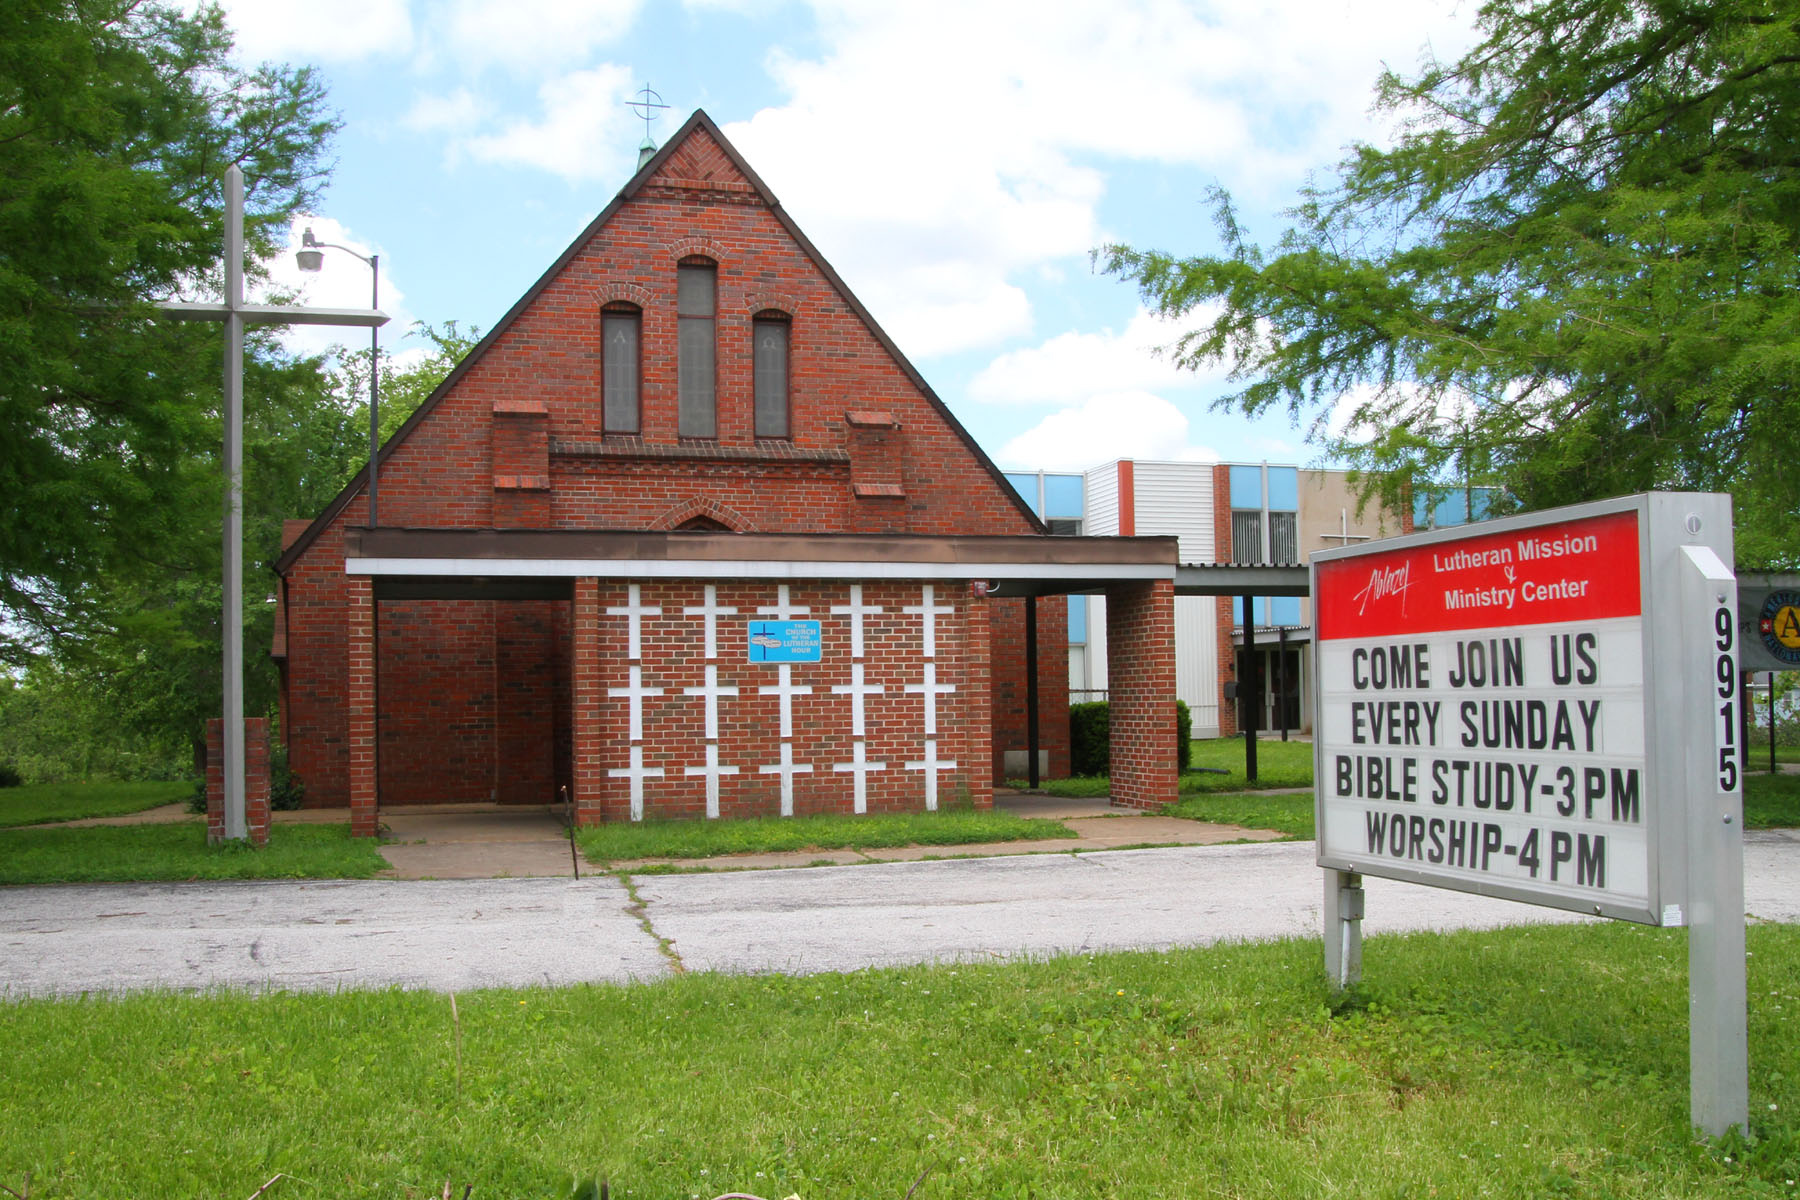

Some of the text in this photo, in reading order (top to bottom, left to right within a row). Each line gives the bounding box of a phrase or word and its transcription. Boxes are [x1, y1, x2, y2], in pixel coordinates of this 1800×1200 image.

[1433, 534, 1597, 573] Lutheran Mission
[1503, 565, 1517, 584] &
[1444, 578, 1589, 609] Ministry Center
[1352, 632, 1598, 690] COME JOIN US
[1715, 607, 1738, 792] 9915
[1352, 700, 1600, 752] EVERY SUNDAY
[1336, 755, 1416, 802] BIBLE
